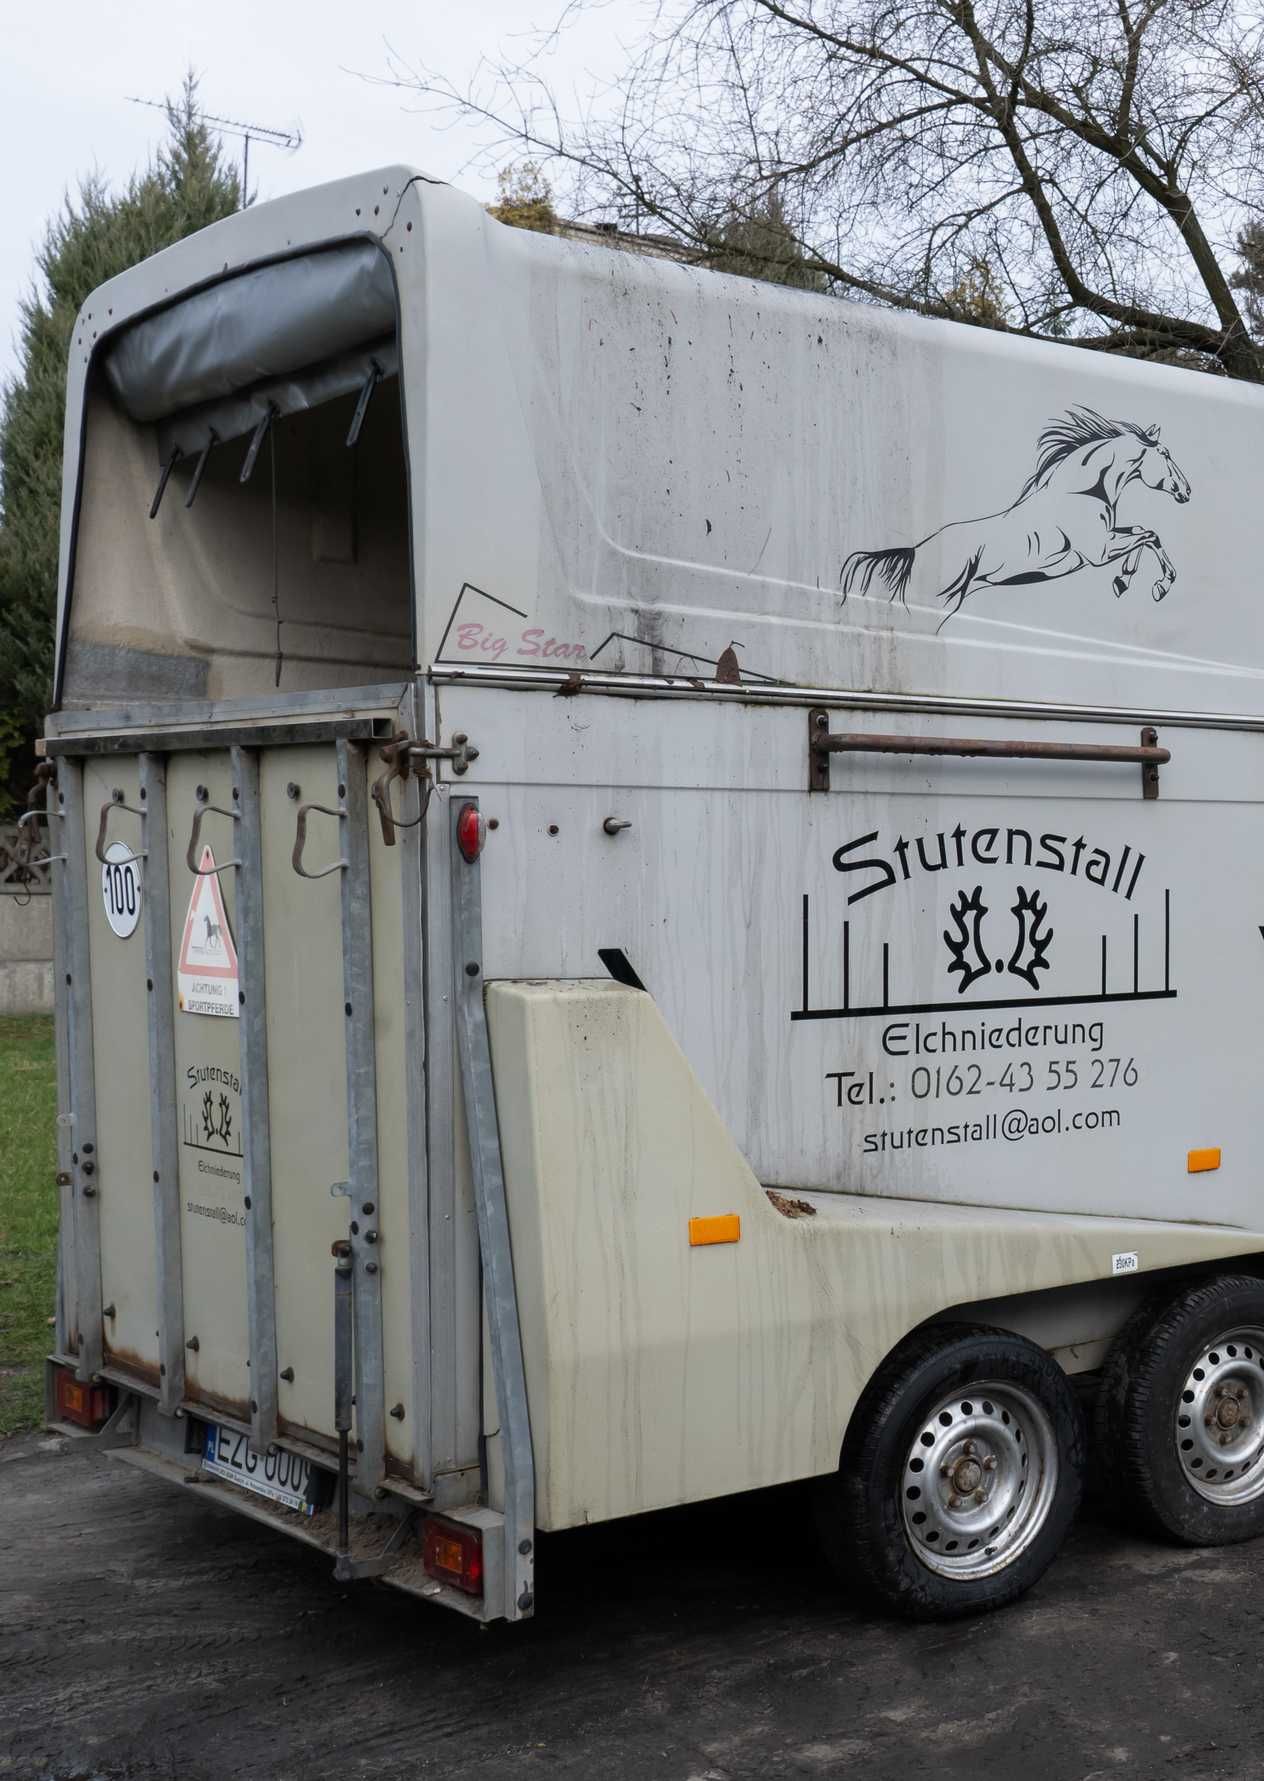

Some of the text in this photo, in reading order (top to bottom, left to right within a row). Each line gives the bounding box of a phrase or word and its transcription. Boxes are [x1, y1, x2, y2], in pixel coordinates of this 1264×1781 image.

[456, 623, 588, 661] Big Star
[832, 822, 1146, 906] Stutenstall
[107, 863, 135, 916] 100
[882, 1018, 1104, 1056] Elchniederung
[187, 1065, 242, 1096] Stutensta
[911, 1062, 1034, 1099] 0162-43
[1046, 1060, 1078, 1091] 55
[1090, 1058, 1139, 1089] 276
[863, 1108, 1121, 1152] stutenstall@aol.com
[218, 1425, 257, 1473] EZG
